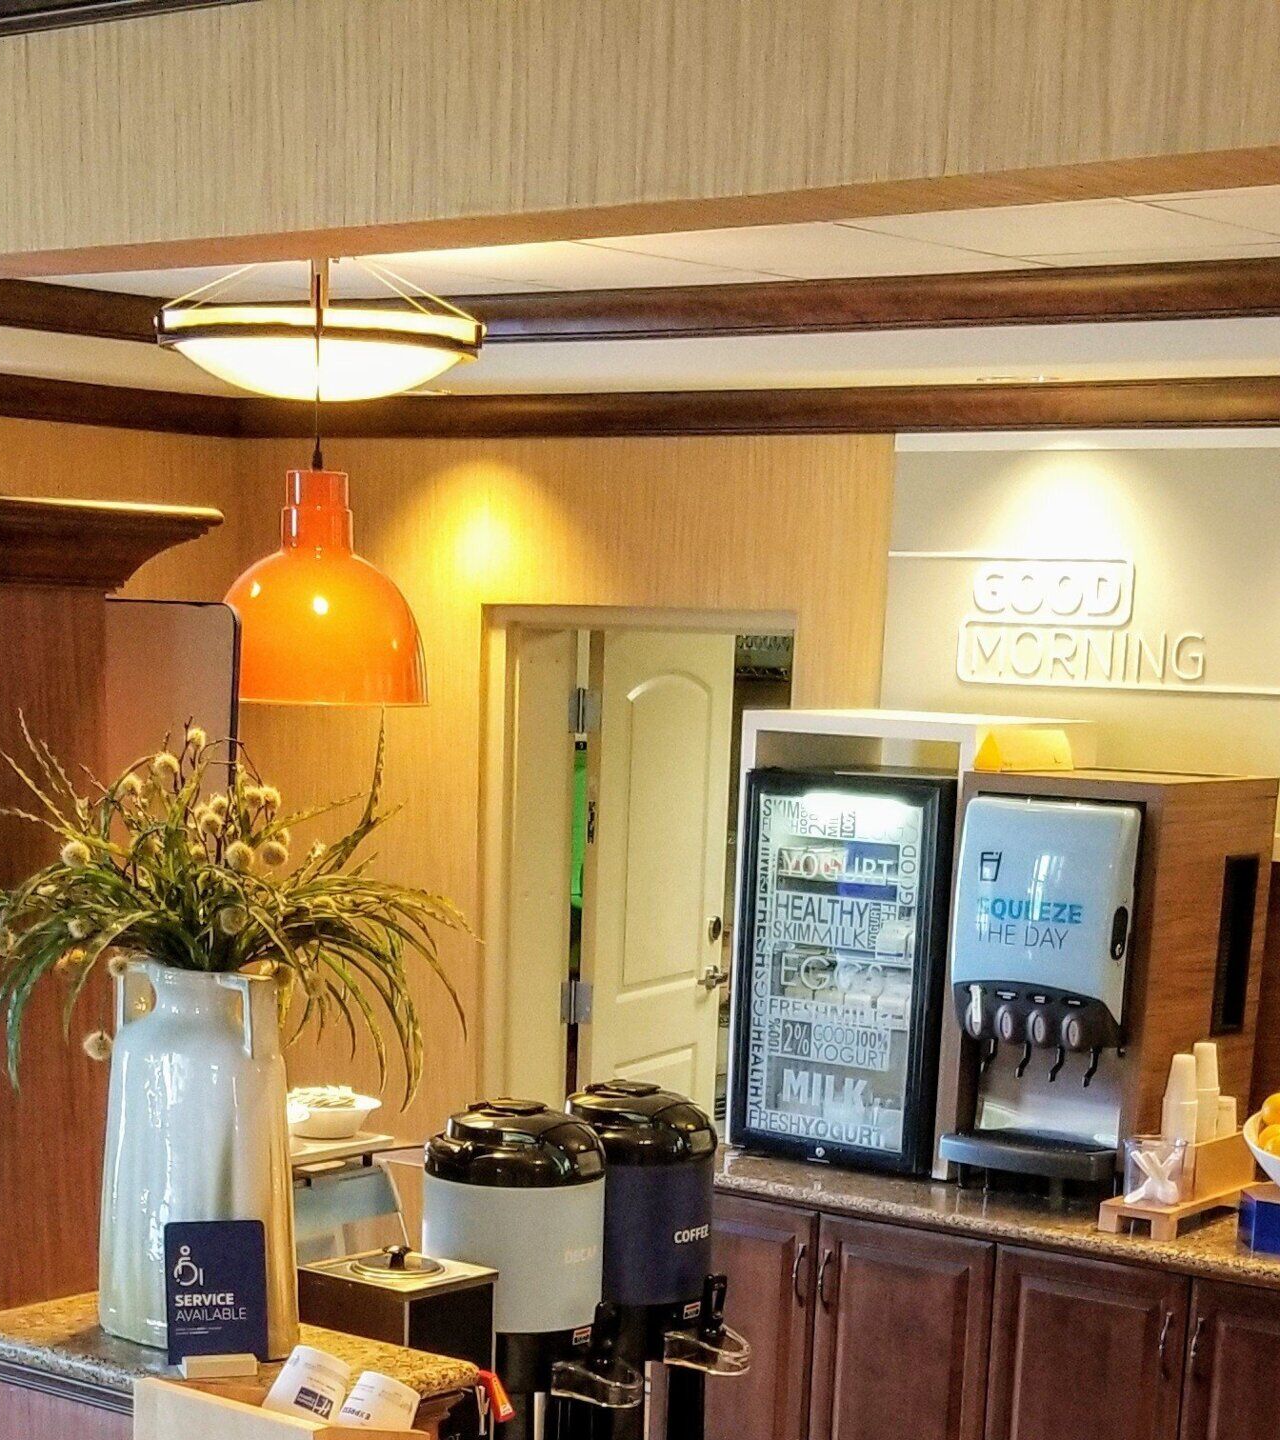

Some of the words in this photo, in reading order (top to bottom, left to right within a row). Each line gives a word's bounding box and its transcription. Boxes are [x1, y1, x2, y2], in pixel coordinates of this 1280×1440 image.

[972, 569, 1122, 616] GOOD
[970, 629, 1206, 684] MORNING
[780, 850, 894, 886] YOGURT
[775, 893, 870, 929] HEALTHY
[976, 922, 1015, 945] THE
[1024, 926, 1069, 950] DAY
[768, 1017, 780, 1053] 100%
[783, 1022, 810, 1055] 2%
[749, 1029, 766, 1111] HEALTHY
[813, 1041, 887, 1068] YOGURT
[782, 1068, 868, 1112] MILK
[174, 1292, 235, 1307] SERVICE
[175, 1307, 247, 1322] AVAILABLE
